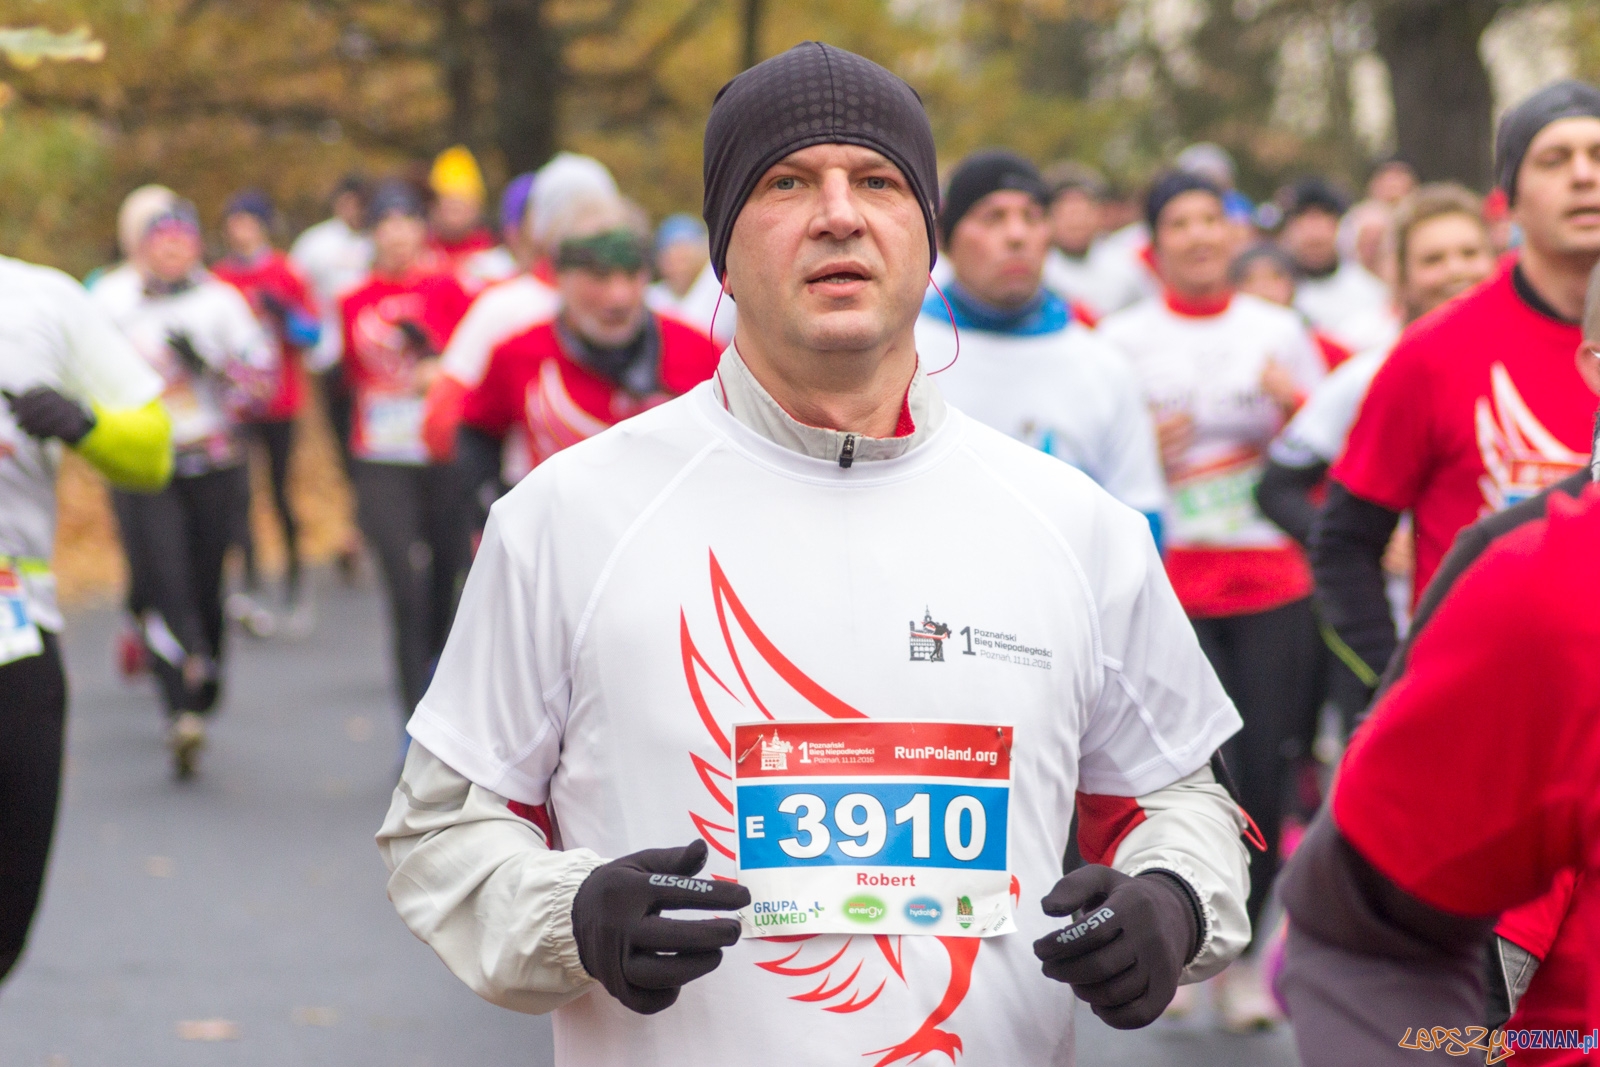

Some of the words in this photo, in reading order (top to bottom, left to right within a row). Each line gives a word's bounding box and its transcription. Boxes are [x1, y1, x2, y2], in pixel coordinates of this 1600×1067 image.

[960, 626, 976, 656] 1
[974, 628, 1017, 642] Poznański
[974, 637, 993, 648] Bieg
[994, 640, 1053, 658] Niepodległości
[798, 741, 811, 763] 1
[809, 748, 825, 756] Bieg
[825, 748, 875, 756] Niepodległości
[894, 745, 998, 766] RunPoland.org
[745, 816, 766, 839] E
[777, 792, 987, 862] 3910
[649, 873, 708, 893] KIPSTA
[856, 872, 916, 887] Robert
[753, 900, 798, 914] GRUPA
[848, 906, 883, 918] energy
[754, 912, 807, 927] LUXMED
[1060, 907, 1115, 944] KIPSTA
